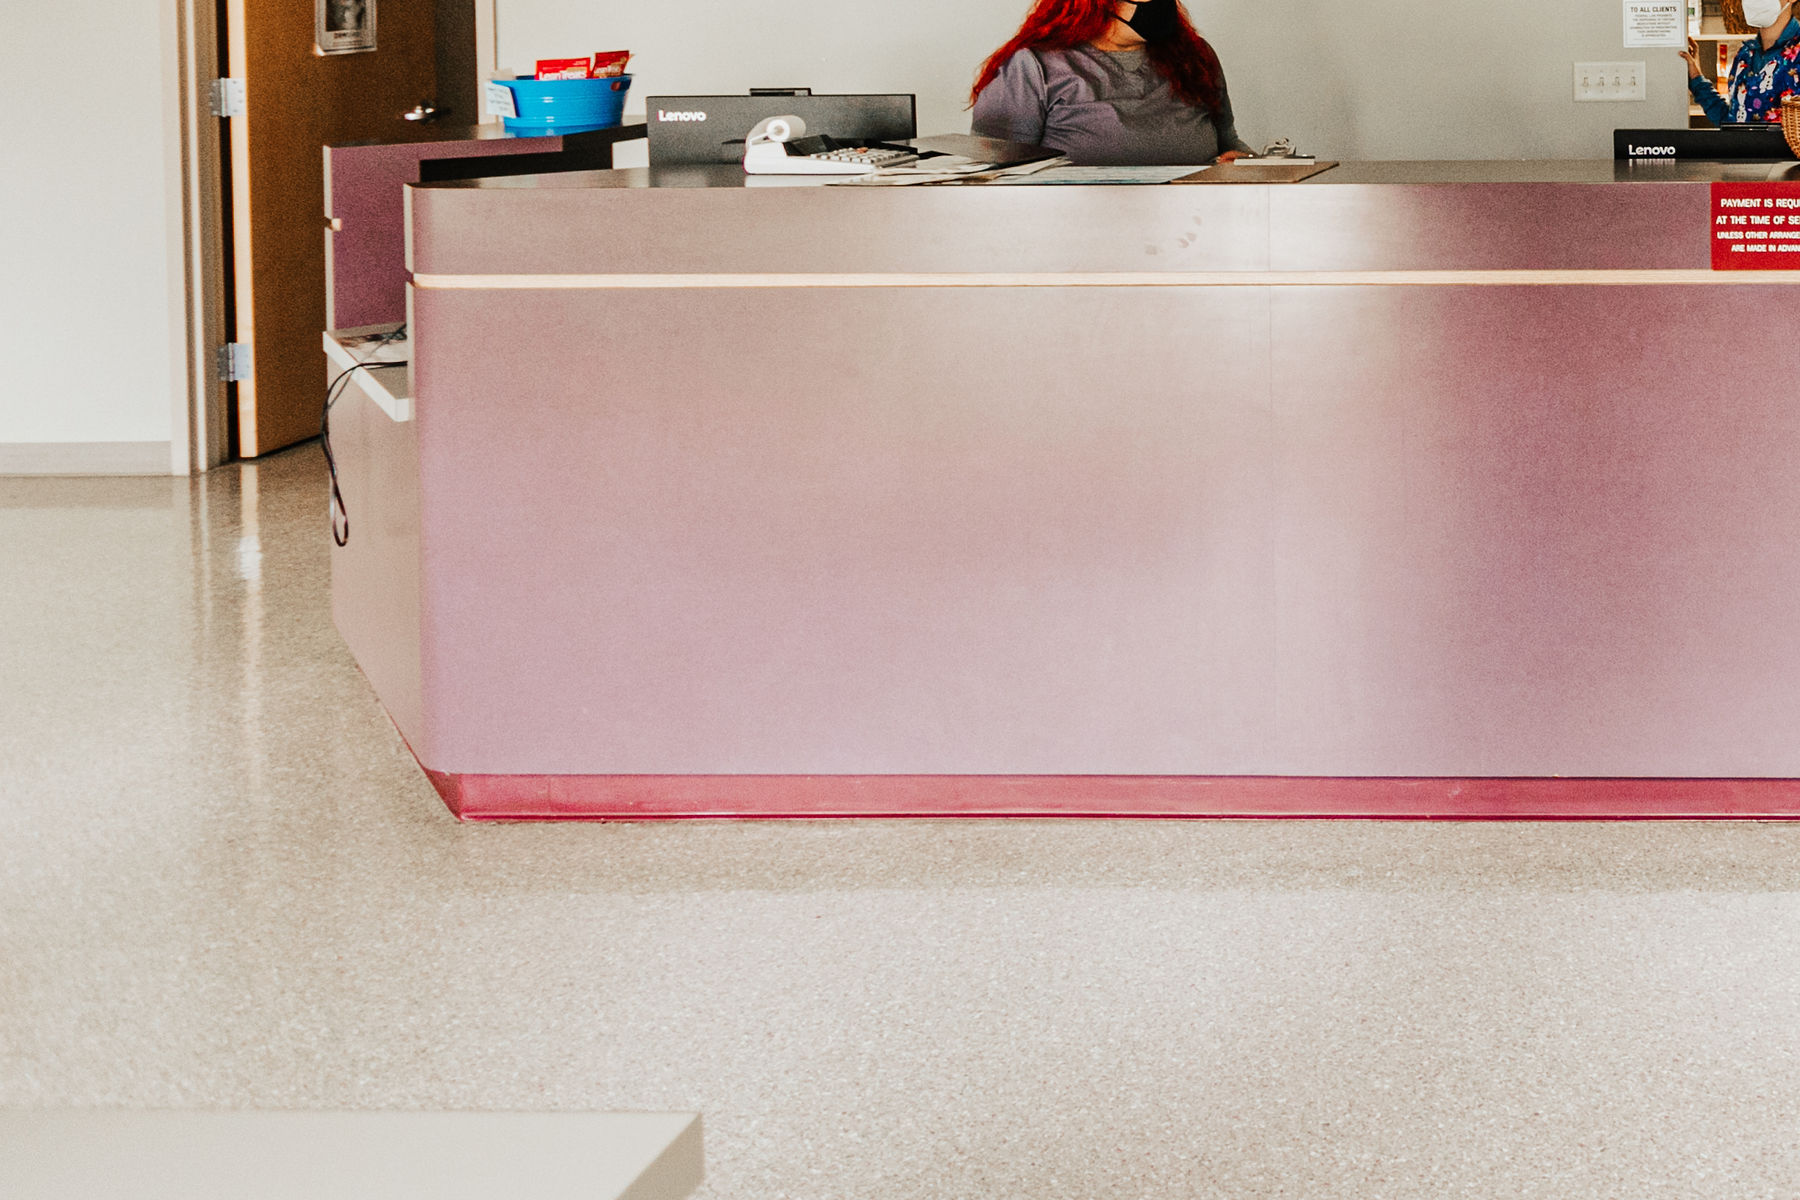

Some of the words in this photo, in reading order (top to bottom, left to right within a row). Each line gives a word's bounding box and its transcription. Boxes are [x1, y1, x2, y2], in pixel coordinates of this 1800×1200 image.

[658, 109, 707, 122] Lenovo
[1628, 144, 1676, 155] Lenovo
[1720, 198, 1762, 208] PAYMENT
[1763, 198, 1773, 208] IS
[1716, 215, 1727, 225] AT
[1730, 215, 1747, 225] THE
[1749, 215, 1770, 225] TIME
[1773, 215, 1785, 225] OF
[1717, 231, 1743, 239] UNLESS
[1745, 231, 1768, 239] OTHER
[1731, 244, 1745, 252] ARE
[1746, 244, 1767, 252] MADE
[1768, 244, 1776, 252] IN
